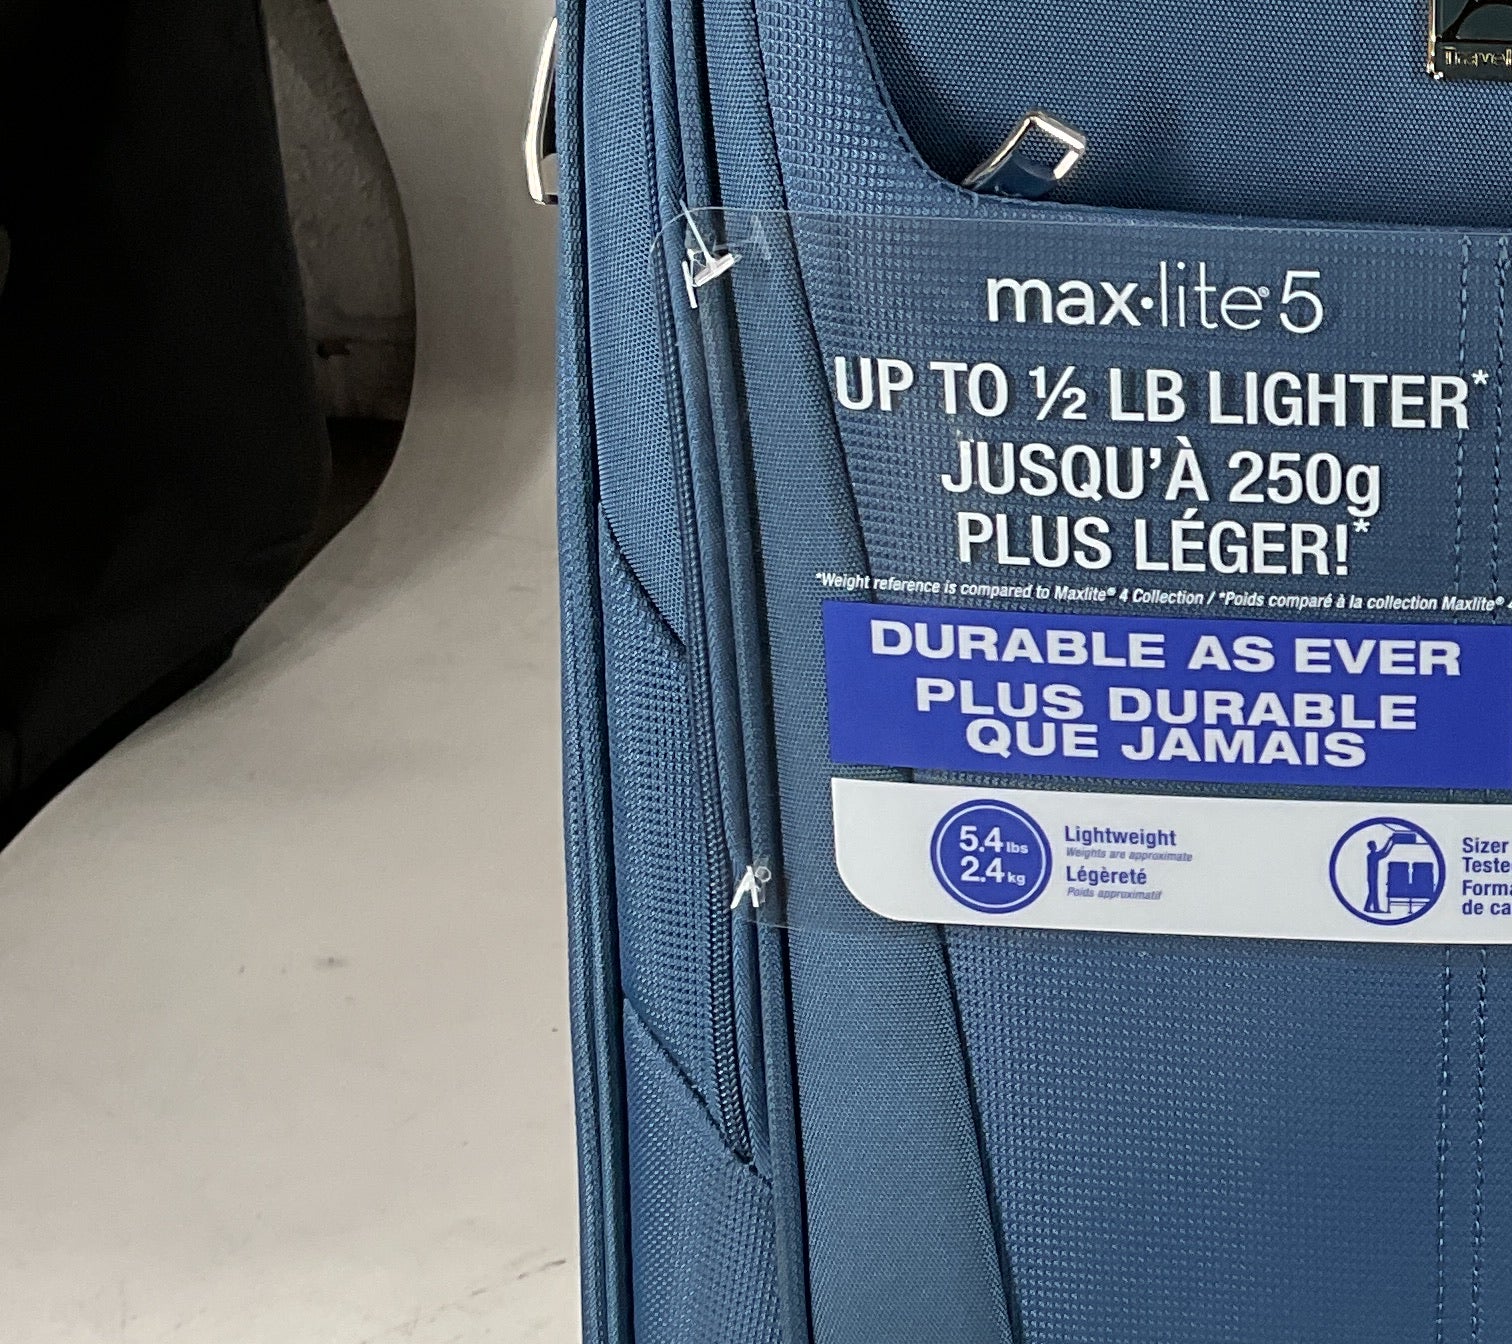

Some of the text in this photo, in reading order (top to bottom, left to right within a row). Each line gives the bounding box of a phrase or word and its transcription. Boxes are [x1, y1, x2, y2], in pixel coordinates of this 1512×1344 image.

[1279, 270, 1324, 334] 5
[834, 355, 914, 412] UP
[930, 360, 1009, 419] TO
[1110, 366, 1186, 424] LB
[1228, 452, 1382, 517] 250g
[957, 511, 1112, 570] PLUS
[873, 577, 940, 594] reference
[944, 580, 957, 595] is
[961, 582, 1033, 601] compared
[1036, 584, 1050, 600] to
[1119, 587, 1129, 602] 4
[1133, 588, 1204, 605] Collection
[1206, 590, 1216, 605] /
[1268, 592, 1333, 611] comparé
[1336, 592, 1346, 608] à
[1349, 594, 1363, 609] la
[1367, 595, 1438, 611] collection
[870, 618, 1461, 676] DURABLE AS EVER
[916, 676, 1418, 731] PLUS DURABLE
[966, 717, 1366, 769] QUE JAMAIS
[959, 825, 1029, 855] 5.4 lbs
[1064, 825, 1177, 849] Lightweight
[1462, 837, 1509, 854] Sizer
[960, 855, 1027, 887] 2.4 kg
[1066, 847, 1193, 864] Weights are approximate
[1066, 865, 1148, 887] Légèreté
[1067, 886, 1162, 902] Poids approximatif
[1462, 899, 1484, 915] de
